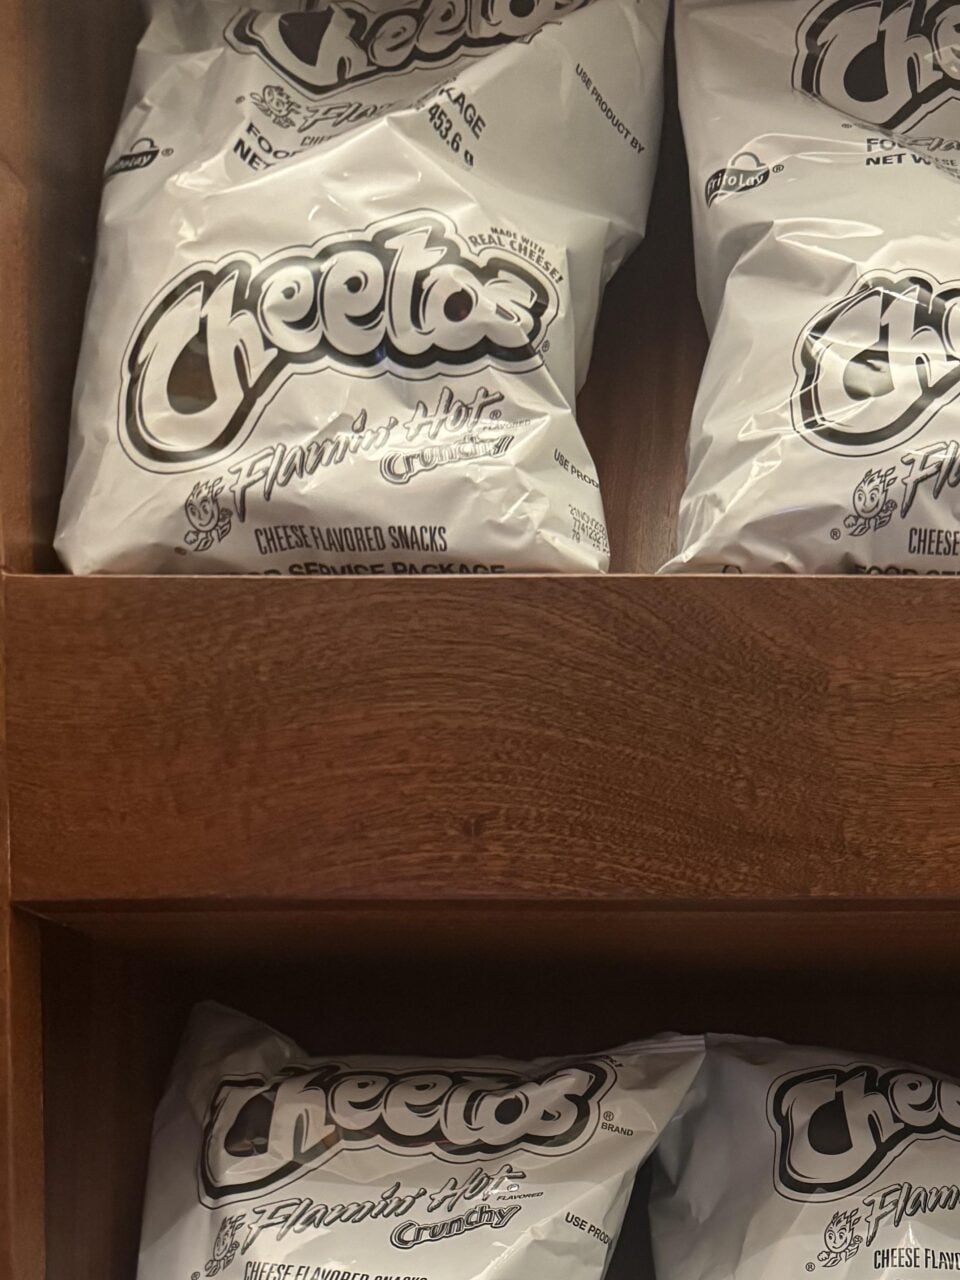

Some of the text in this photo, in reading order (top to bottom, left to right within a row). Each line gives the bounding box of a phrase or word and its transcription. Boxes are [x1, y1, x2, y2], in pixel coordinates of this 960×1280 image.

[468, 233, 564, 284] REAL CHEESE!
[124, 212, 553, 465] Cheetos
[254, 523, 448, 556] CHEESE FLAVORED SNACKS
[907, 527, 960, 556] CHEESE
[601, 1121, 634, 1137] BRAND
[496, 1191, 544, 1201] FLAVORED
[390, 1203, 522, 1250] Crunchy
[873, 1248, 921, 1270] CHEESE
